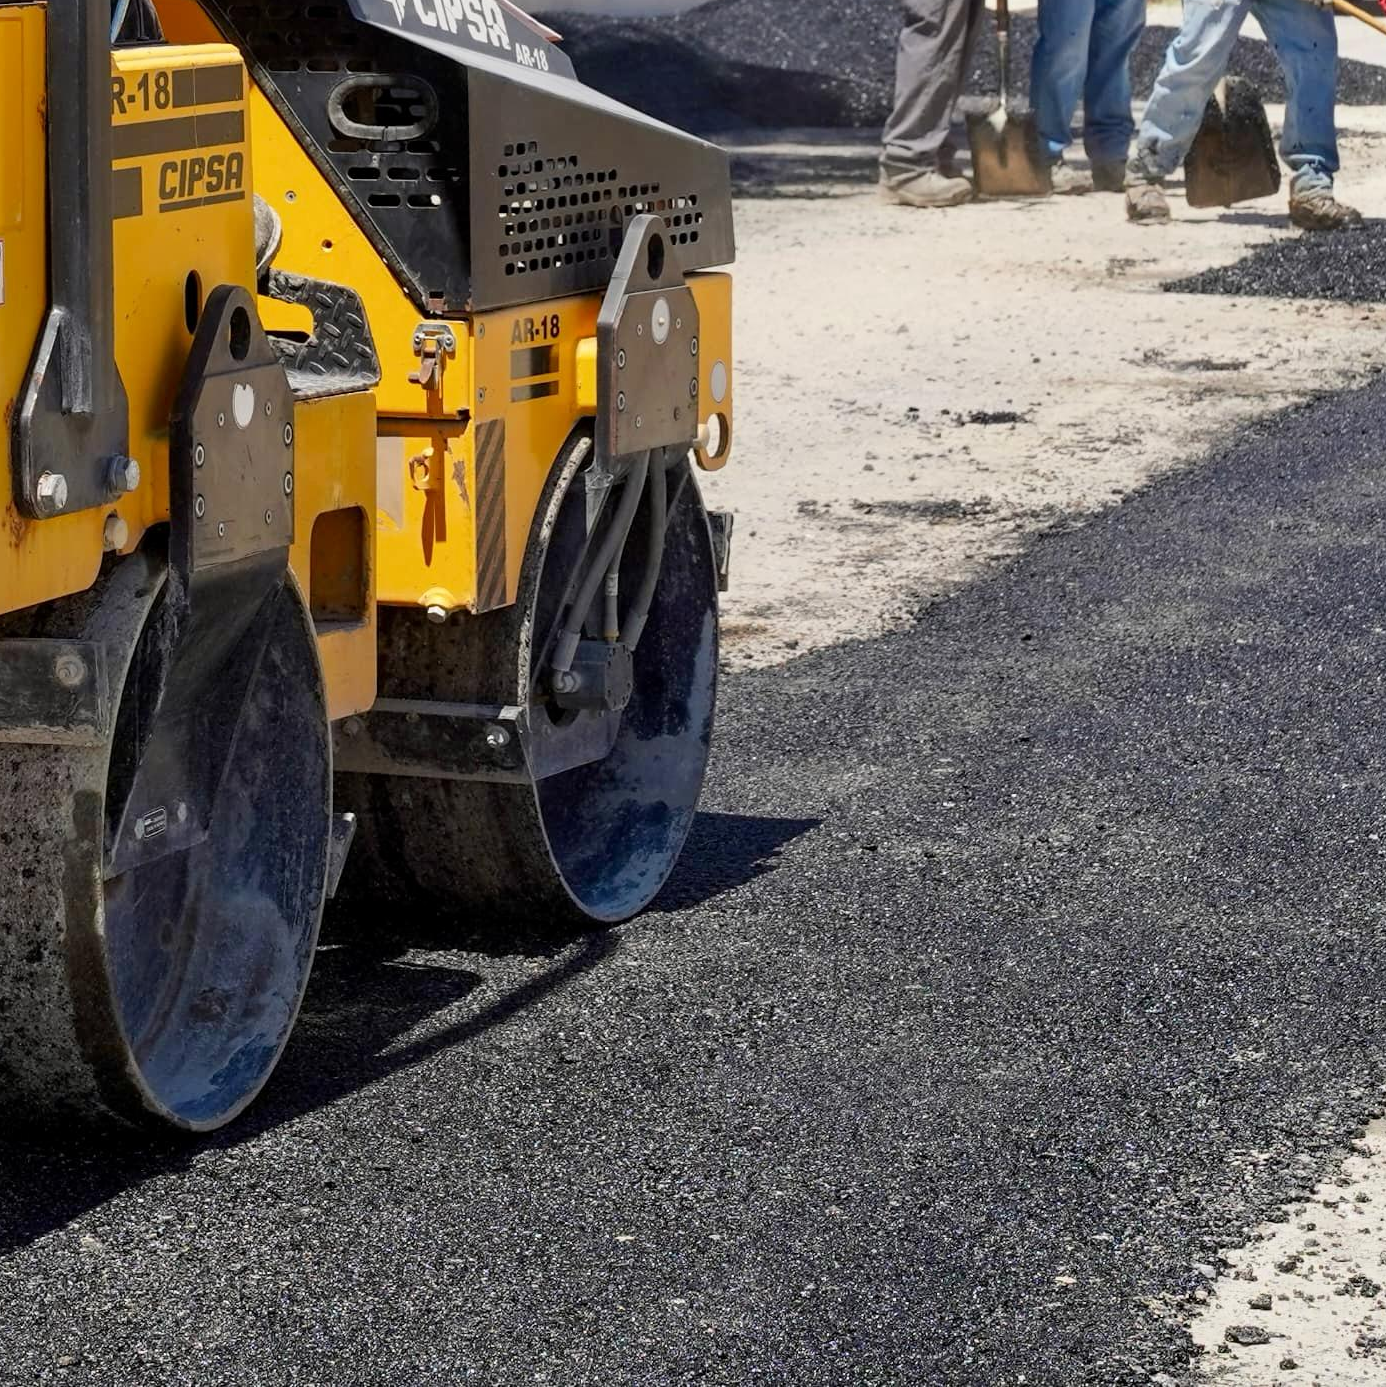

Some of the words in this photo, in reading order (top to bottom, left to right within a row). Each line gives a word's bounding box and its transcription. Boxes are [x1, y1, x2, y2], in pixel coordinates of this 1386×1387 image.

[515, 43, 549, 71] AR-18
[111, 71, 170, 114] R-18
[159, 152, 244, 200] CIPSA
[511, 314, 560, 344] AR-18
